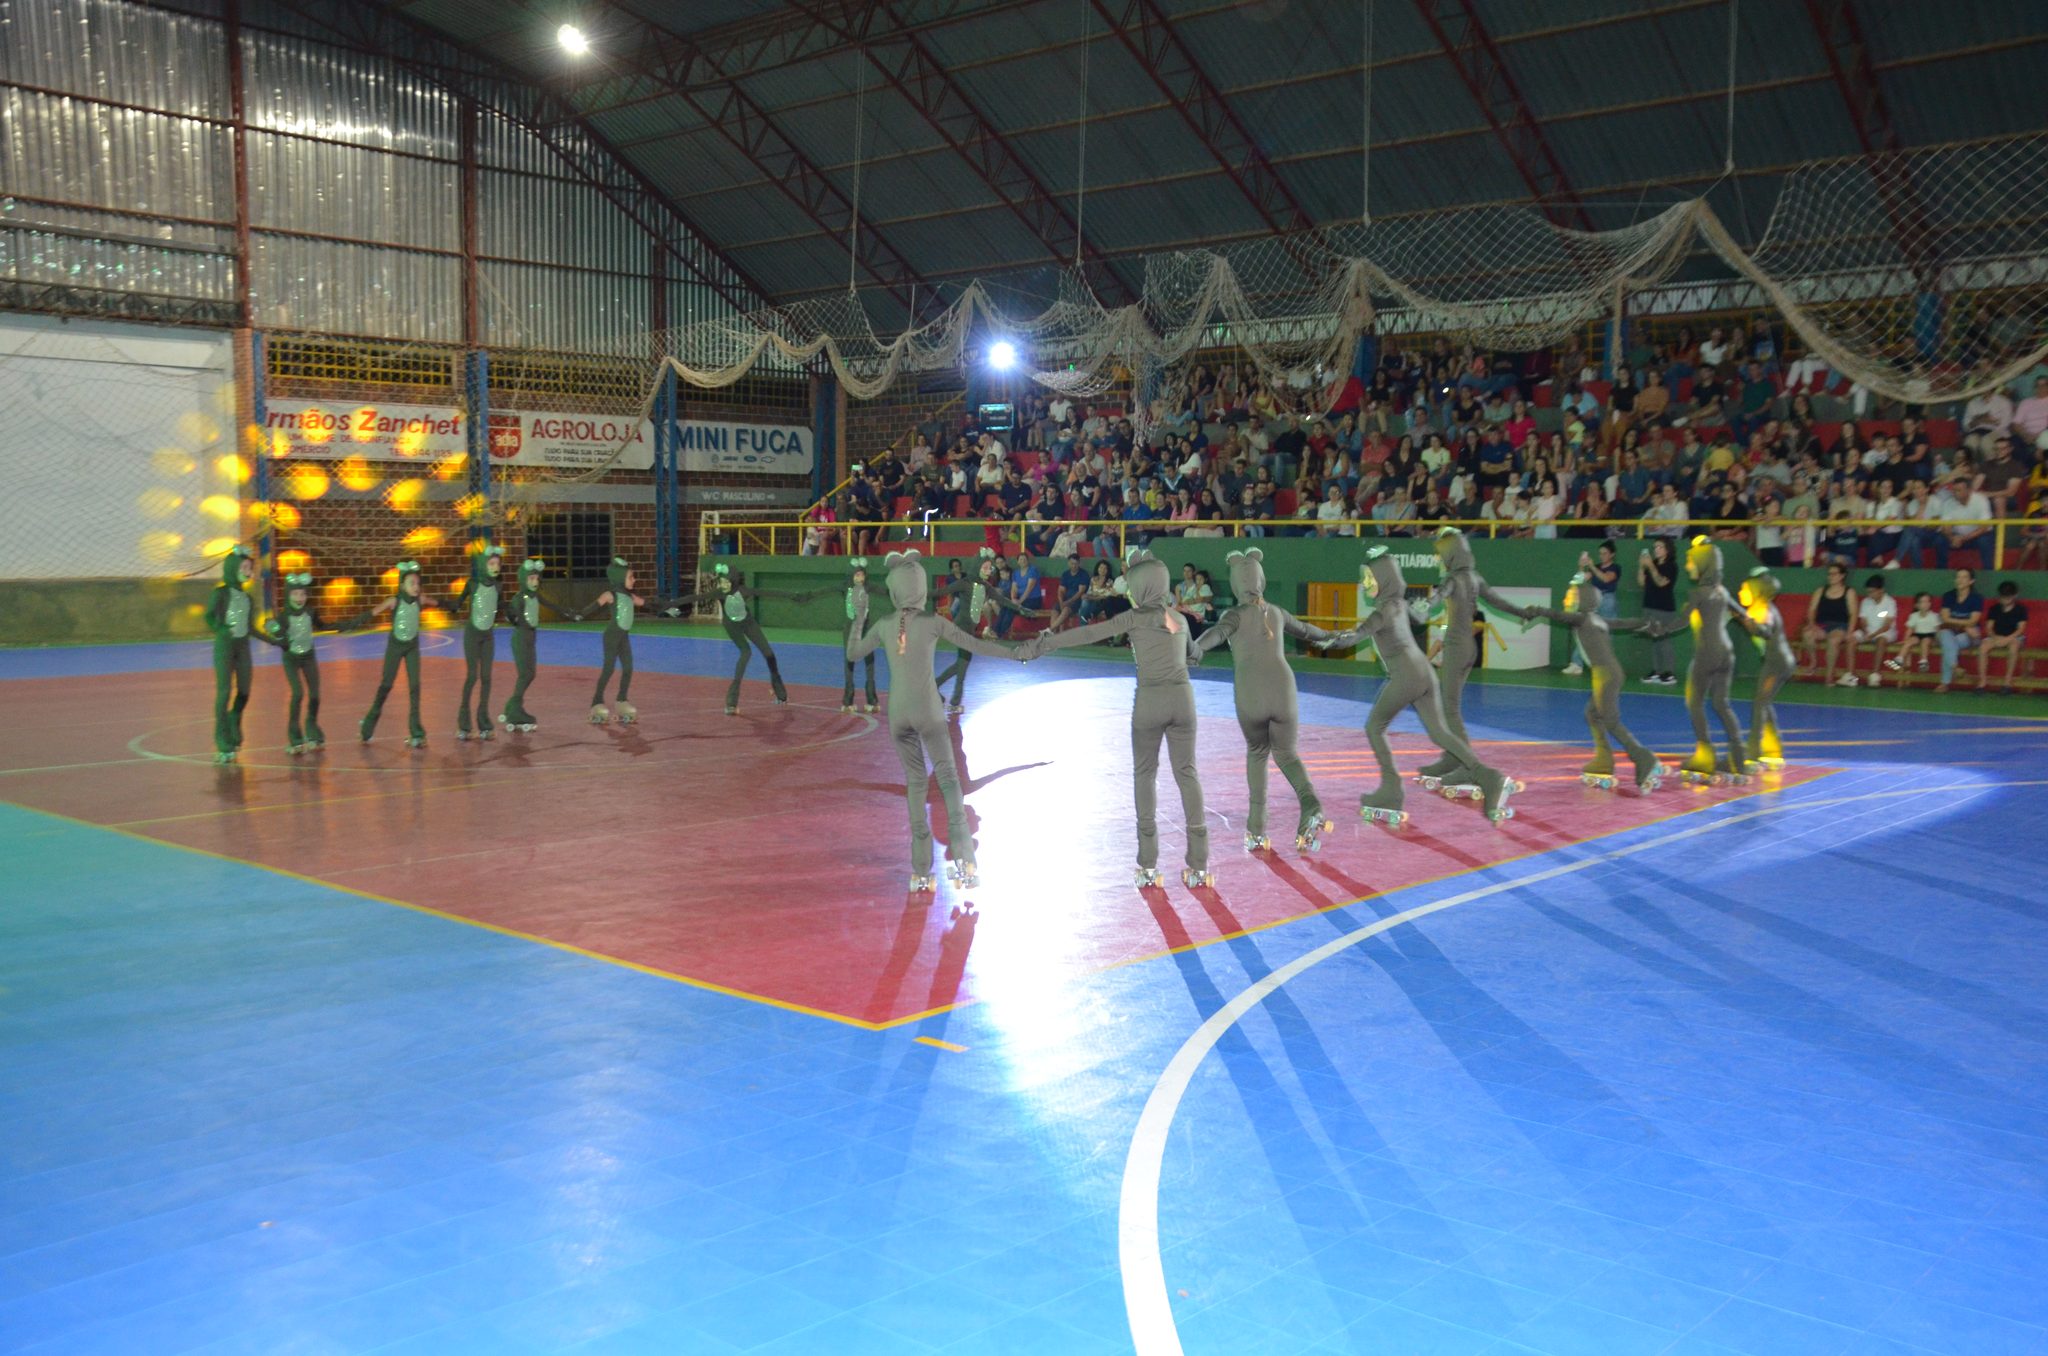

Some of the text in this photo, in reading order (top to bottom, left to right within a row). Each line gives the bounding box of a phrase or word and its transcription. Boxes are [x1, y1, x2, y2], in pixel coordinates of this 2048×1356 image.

[359, 410, 460, 435] Zanchet
[531, 418, 644, 443] AGROLOJA
[676, 425, 804, 456] MINI FUCA
[702, 491, 720, 501] WC
